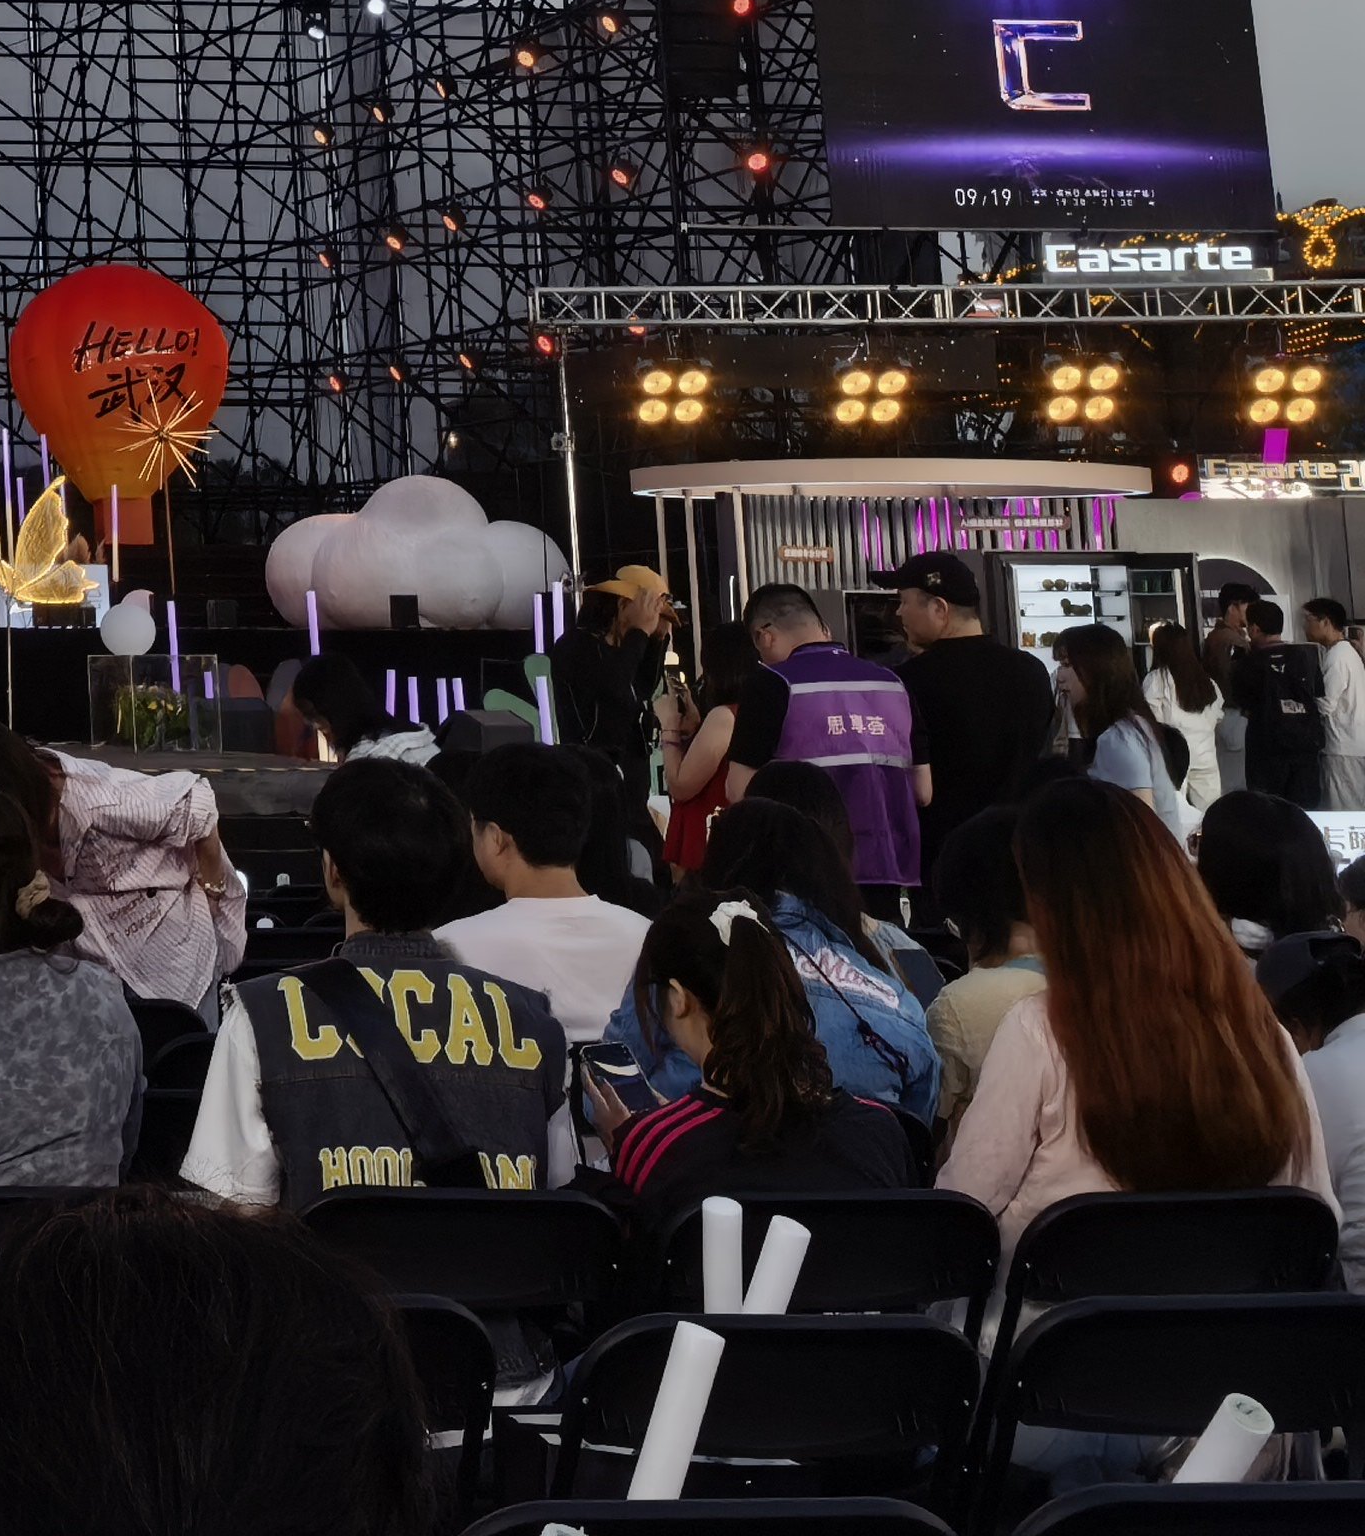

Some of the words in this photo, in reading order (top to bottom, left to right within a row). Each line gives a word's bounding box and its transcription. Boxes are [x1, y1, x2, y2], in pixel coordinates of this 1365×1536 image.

[954, 188, 1012, 206] 09/19
[1044, 243, 1253, 273] Casarte
[72, 321, 200, 372] HELLO!
[87, 362, 195, 423] 武汉
[1203, 458, 1338, 479] Casarte
